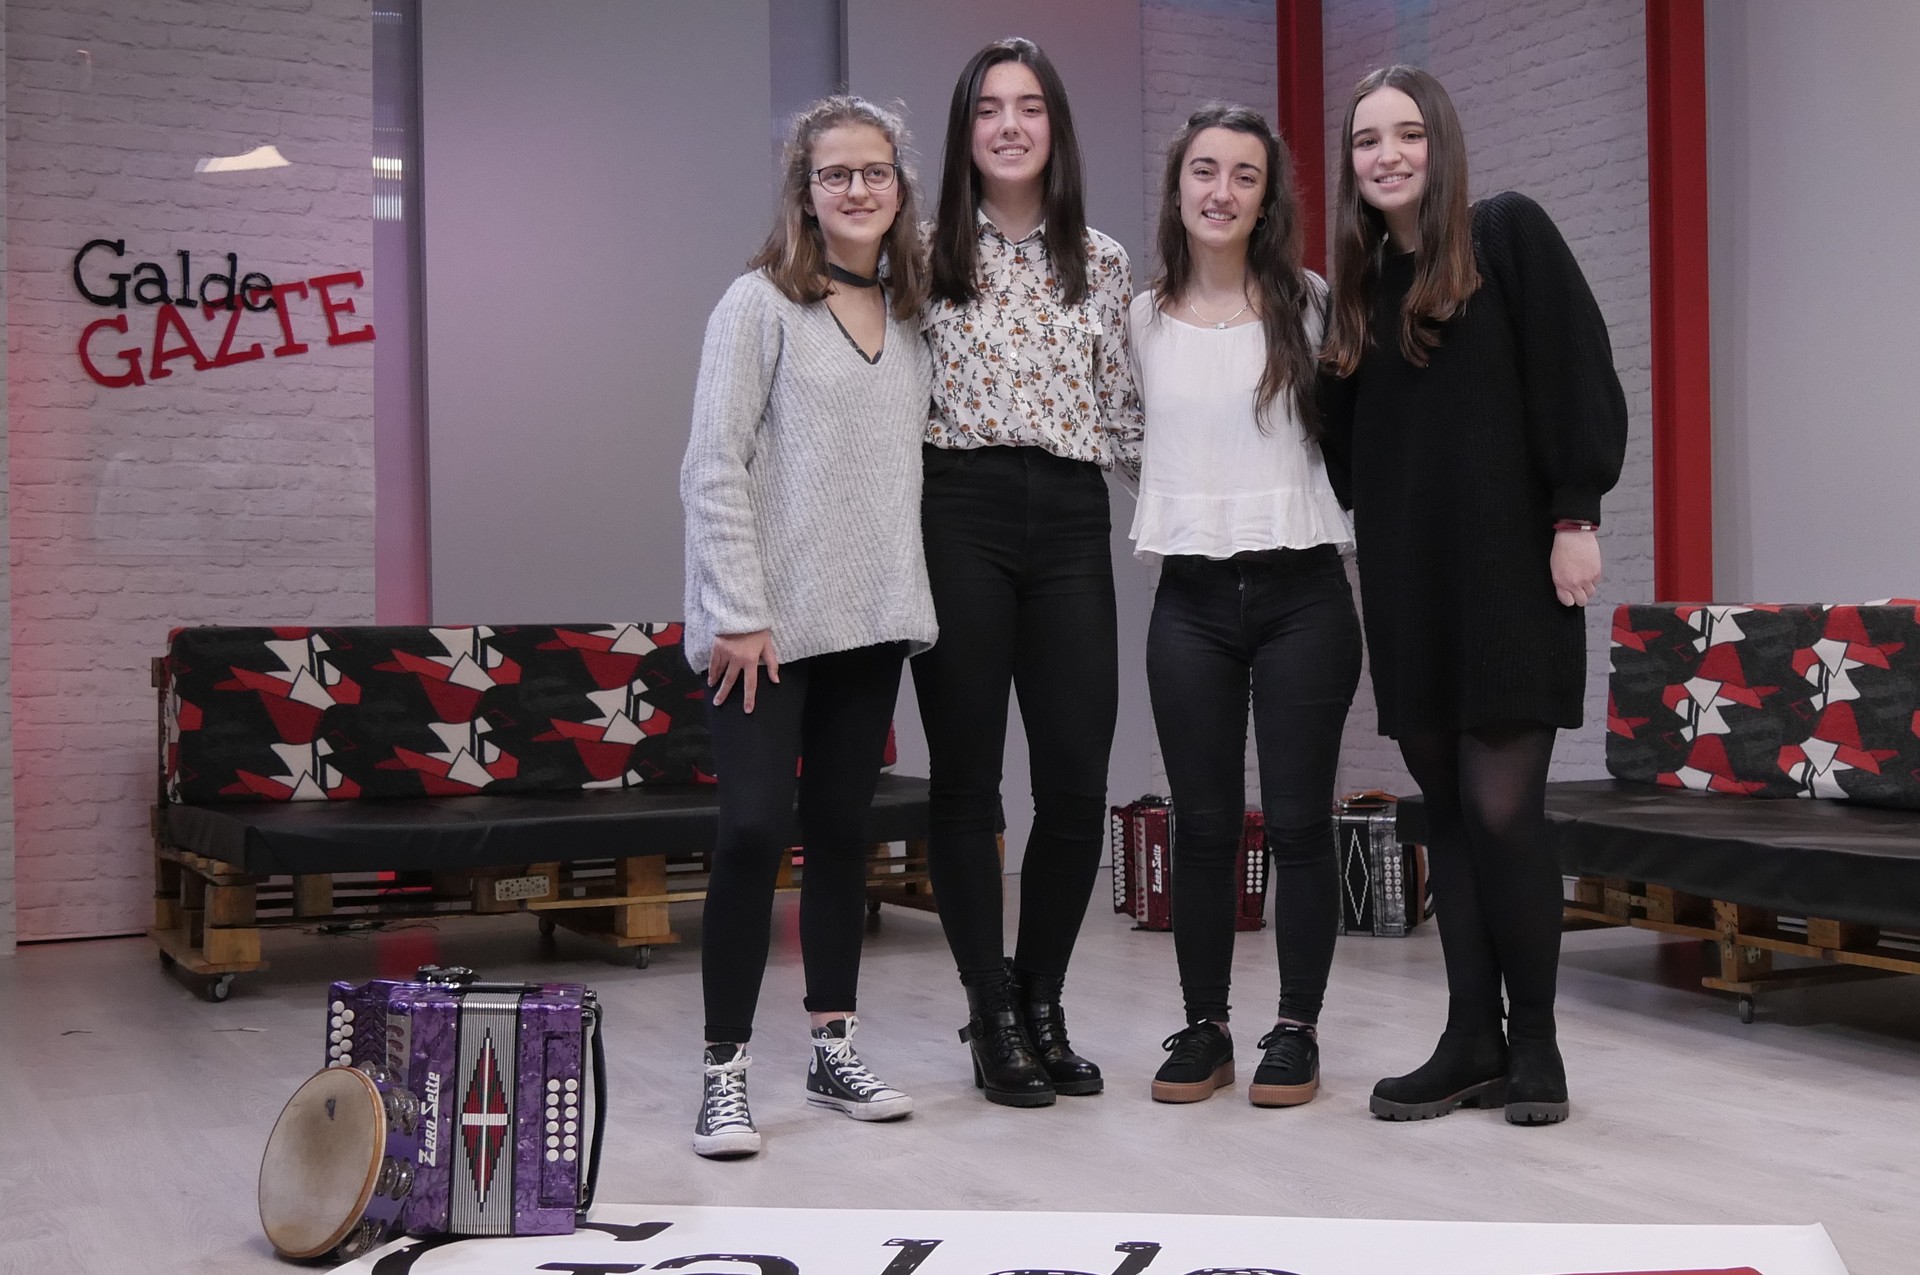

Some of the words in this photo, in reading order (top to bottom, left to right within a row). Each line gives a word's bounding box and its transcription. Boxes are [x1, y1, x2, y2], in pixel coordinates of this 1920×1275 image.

[74, 238, 278, 313] Galde
[78, 271, 376, 388] GAZTE
[420, 1071, 440, 1118] Sette
